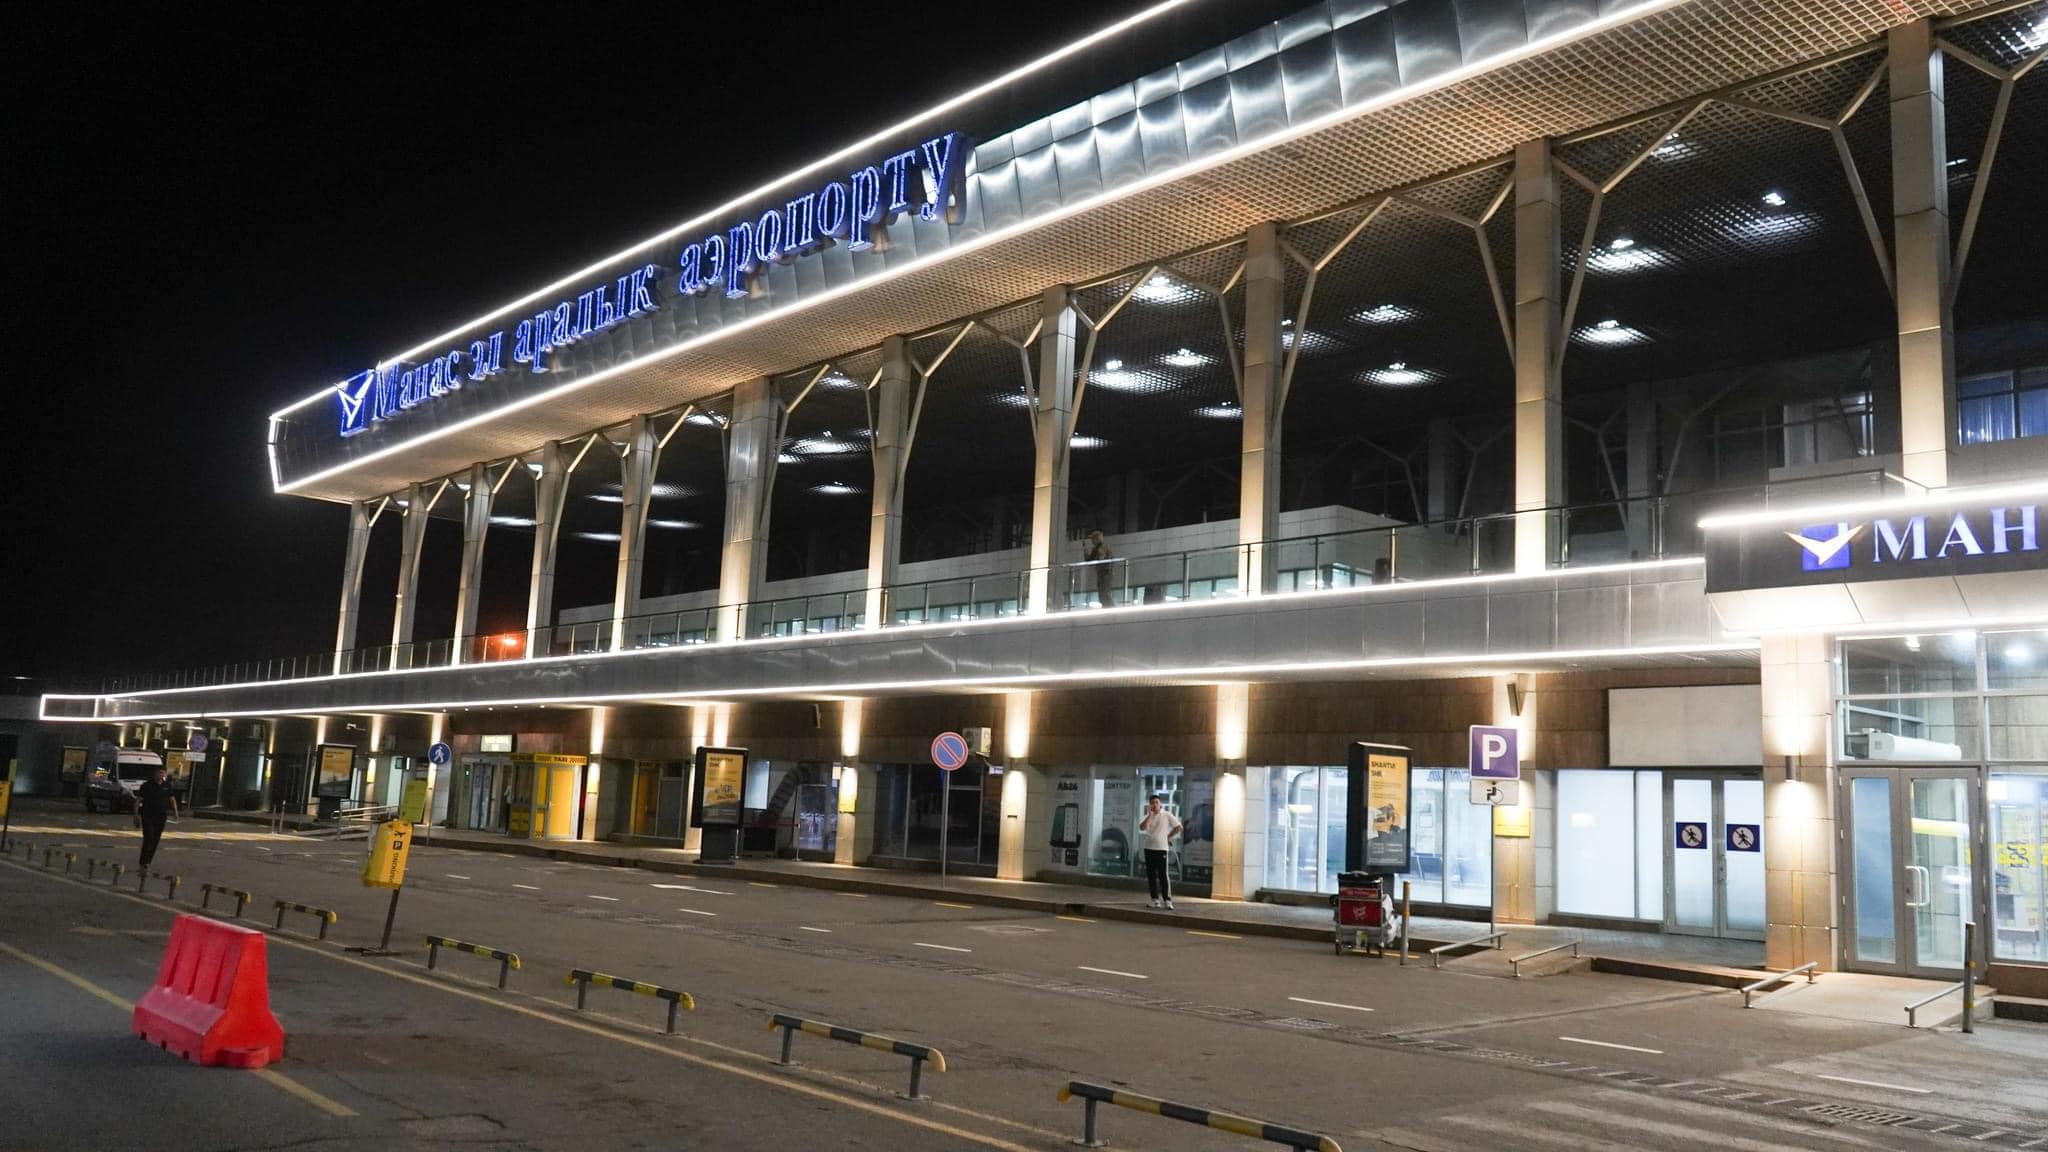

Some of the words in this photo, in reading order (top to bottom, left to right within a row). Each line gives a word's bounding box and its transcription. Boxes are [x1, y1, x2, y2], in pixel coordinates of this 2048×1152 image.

[372, 351, 460, 420] Манас
[469, 331, 504, 381] эл
[514, 263, 657, 374] аралык
[679, 131, 958, 299] аэропорту
[1872, 504, 2040, 563] МАН
[1482, 734, 1507, 770] P
